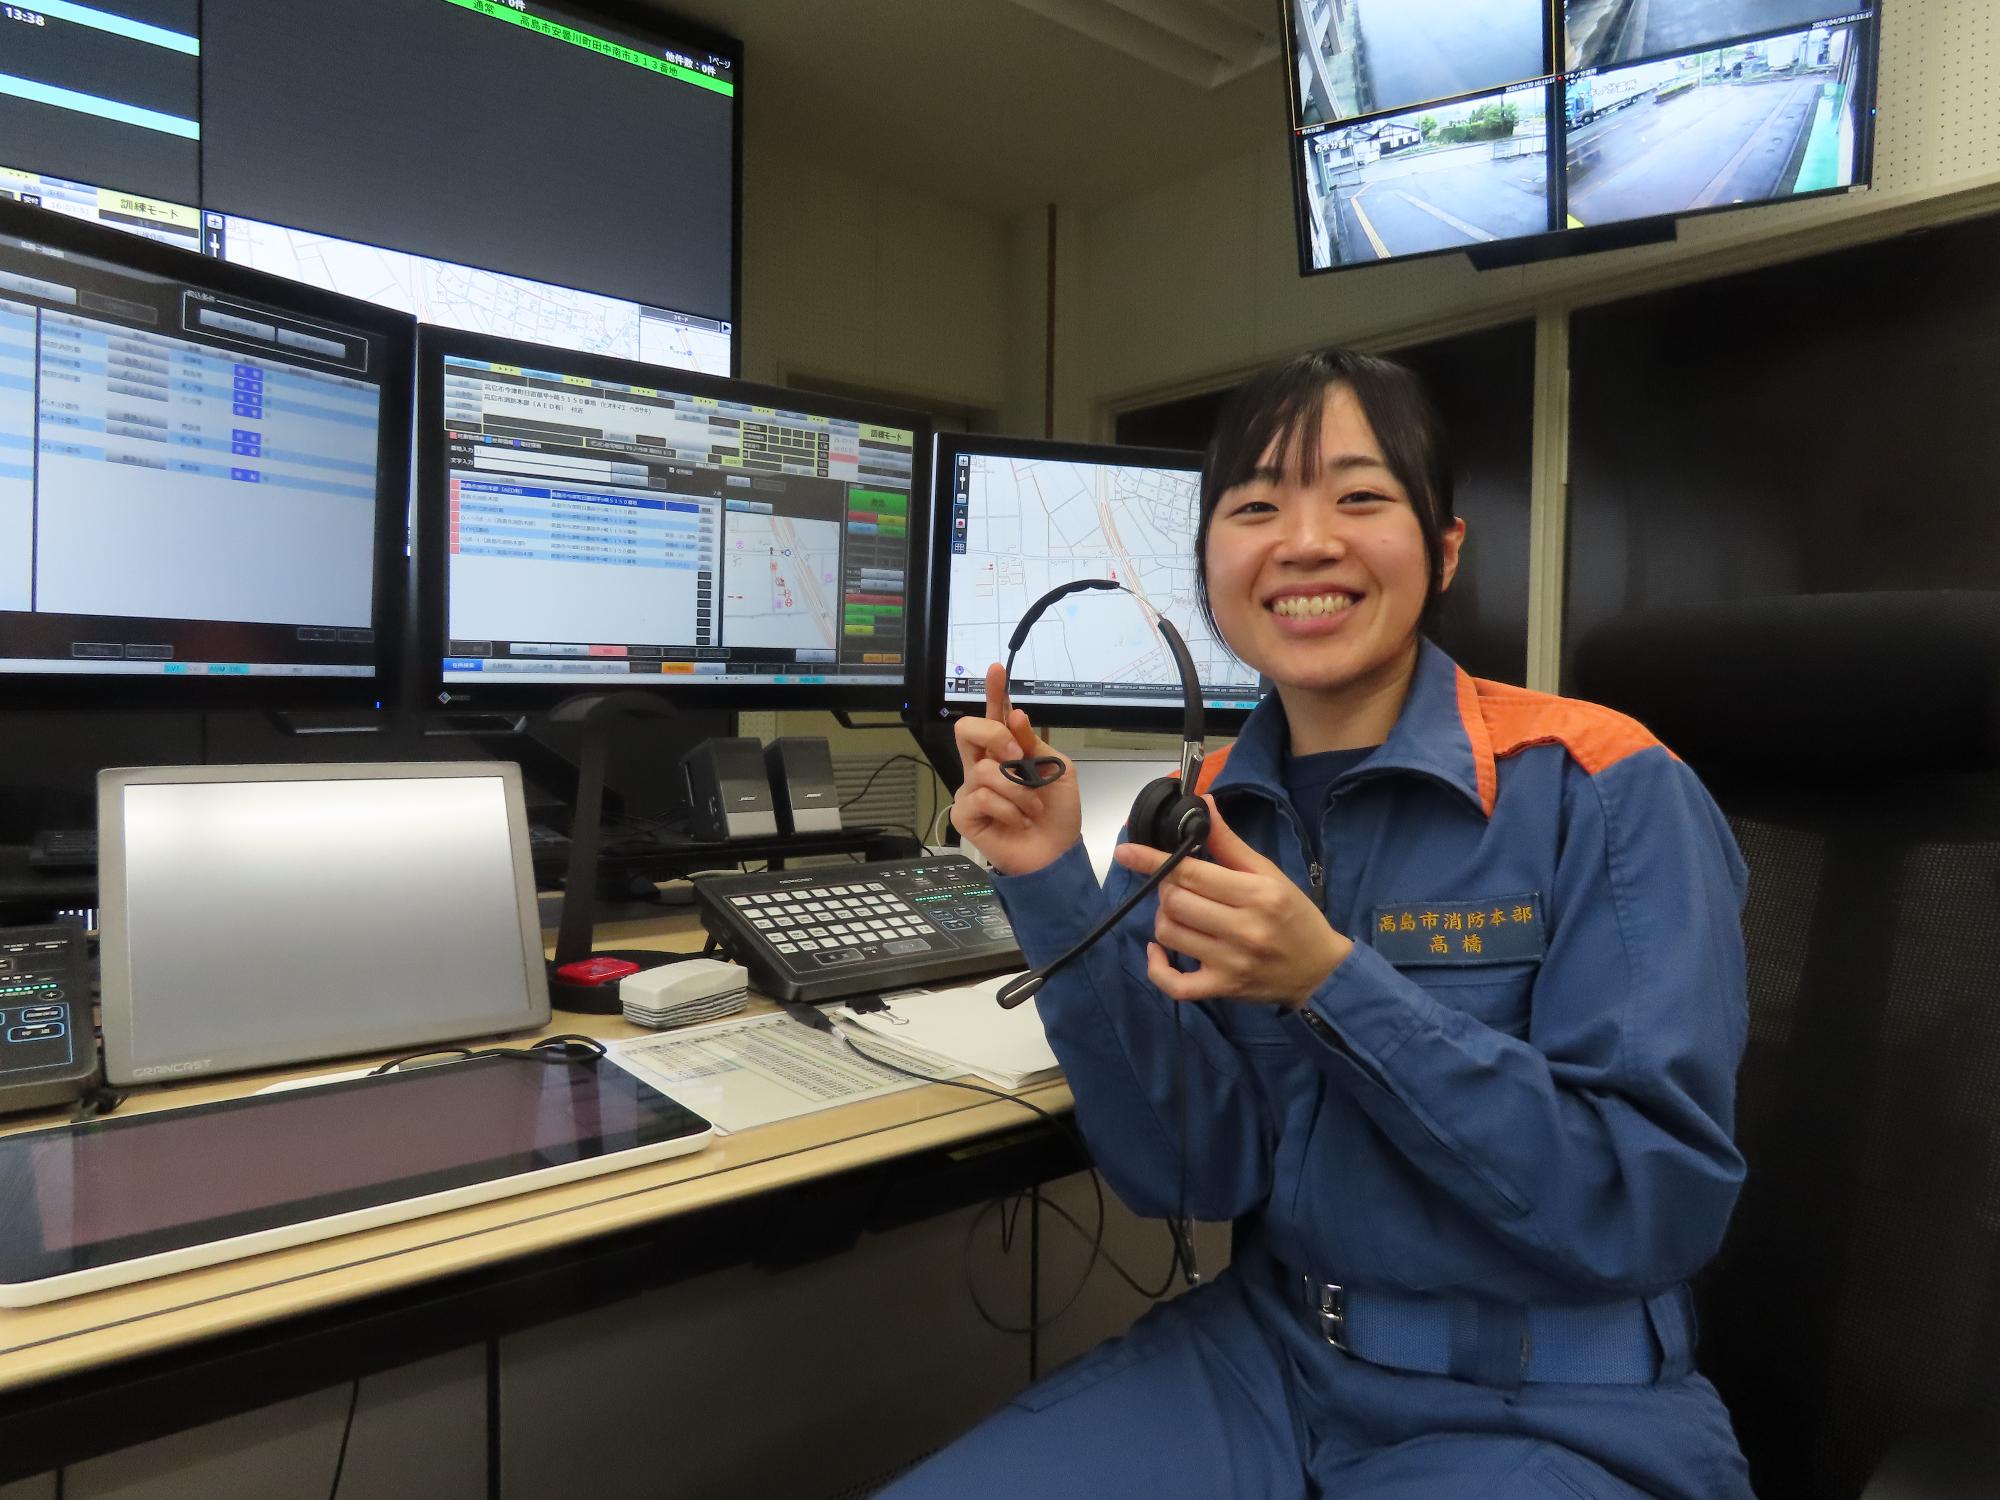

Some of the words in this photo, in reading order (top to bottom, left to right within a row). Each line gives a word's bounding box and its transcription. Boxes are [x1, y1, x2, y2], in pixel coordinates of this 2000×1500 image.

[4, 6, 46, 27] 13:38
[1378, 905, 1533, 932] 高島市消防本部
[1429, 934, 1483, 954] 高橋
[132, 1059, 212, 1078] GRANCAST
